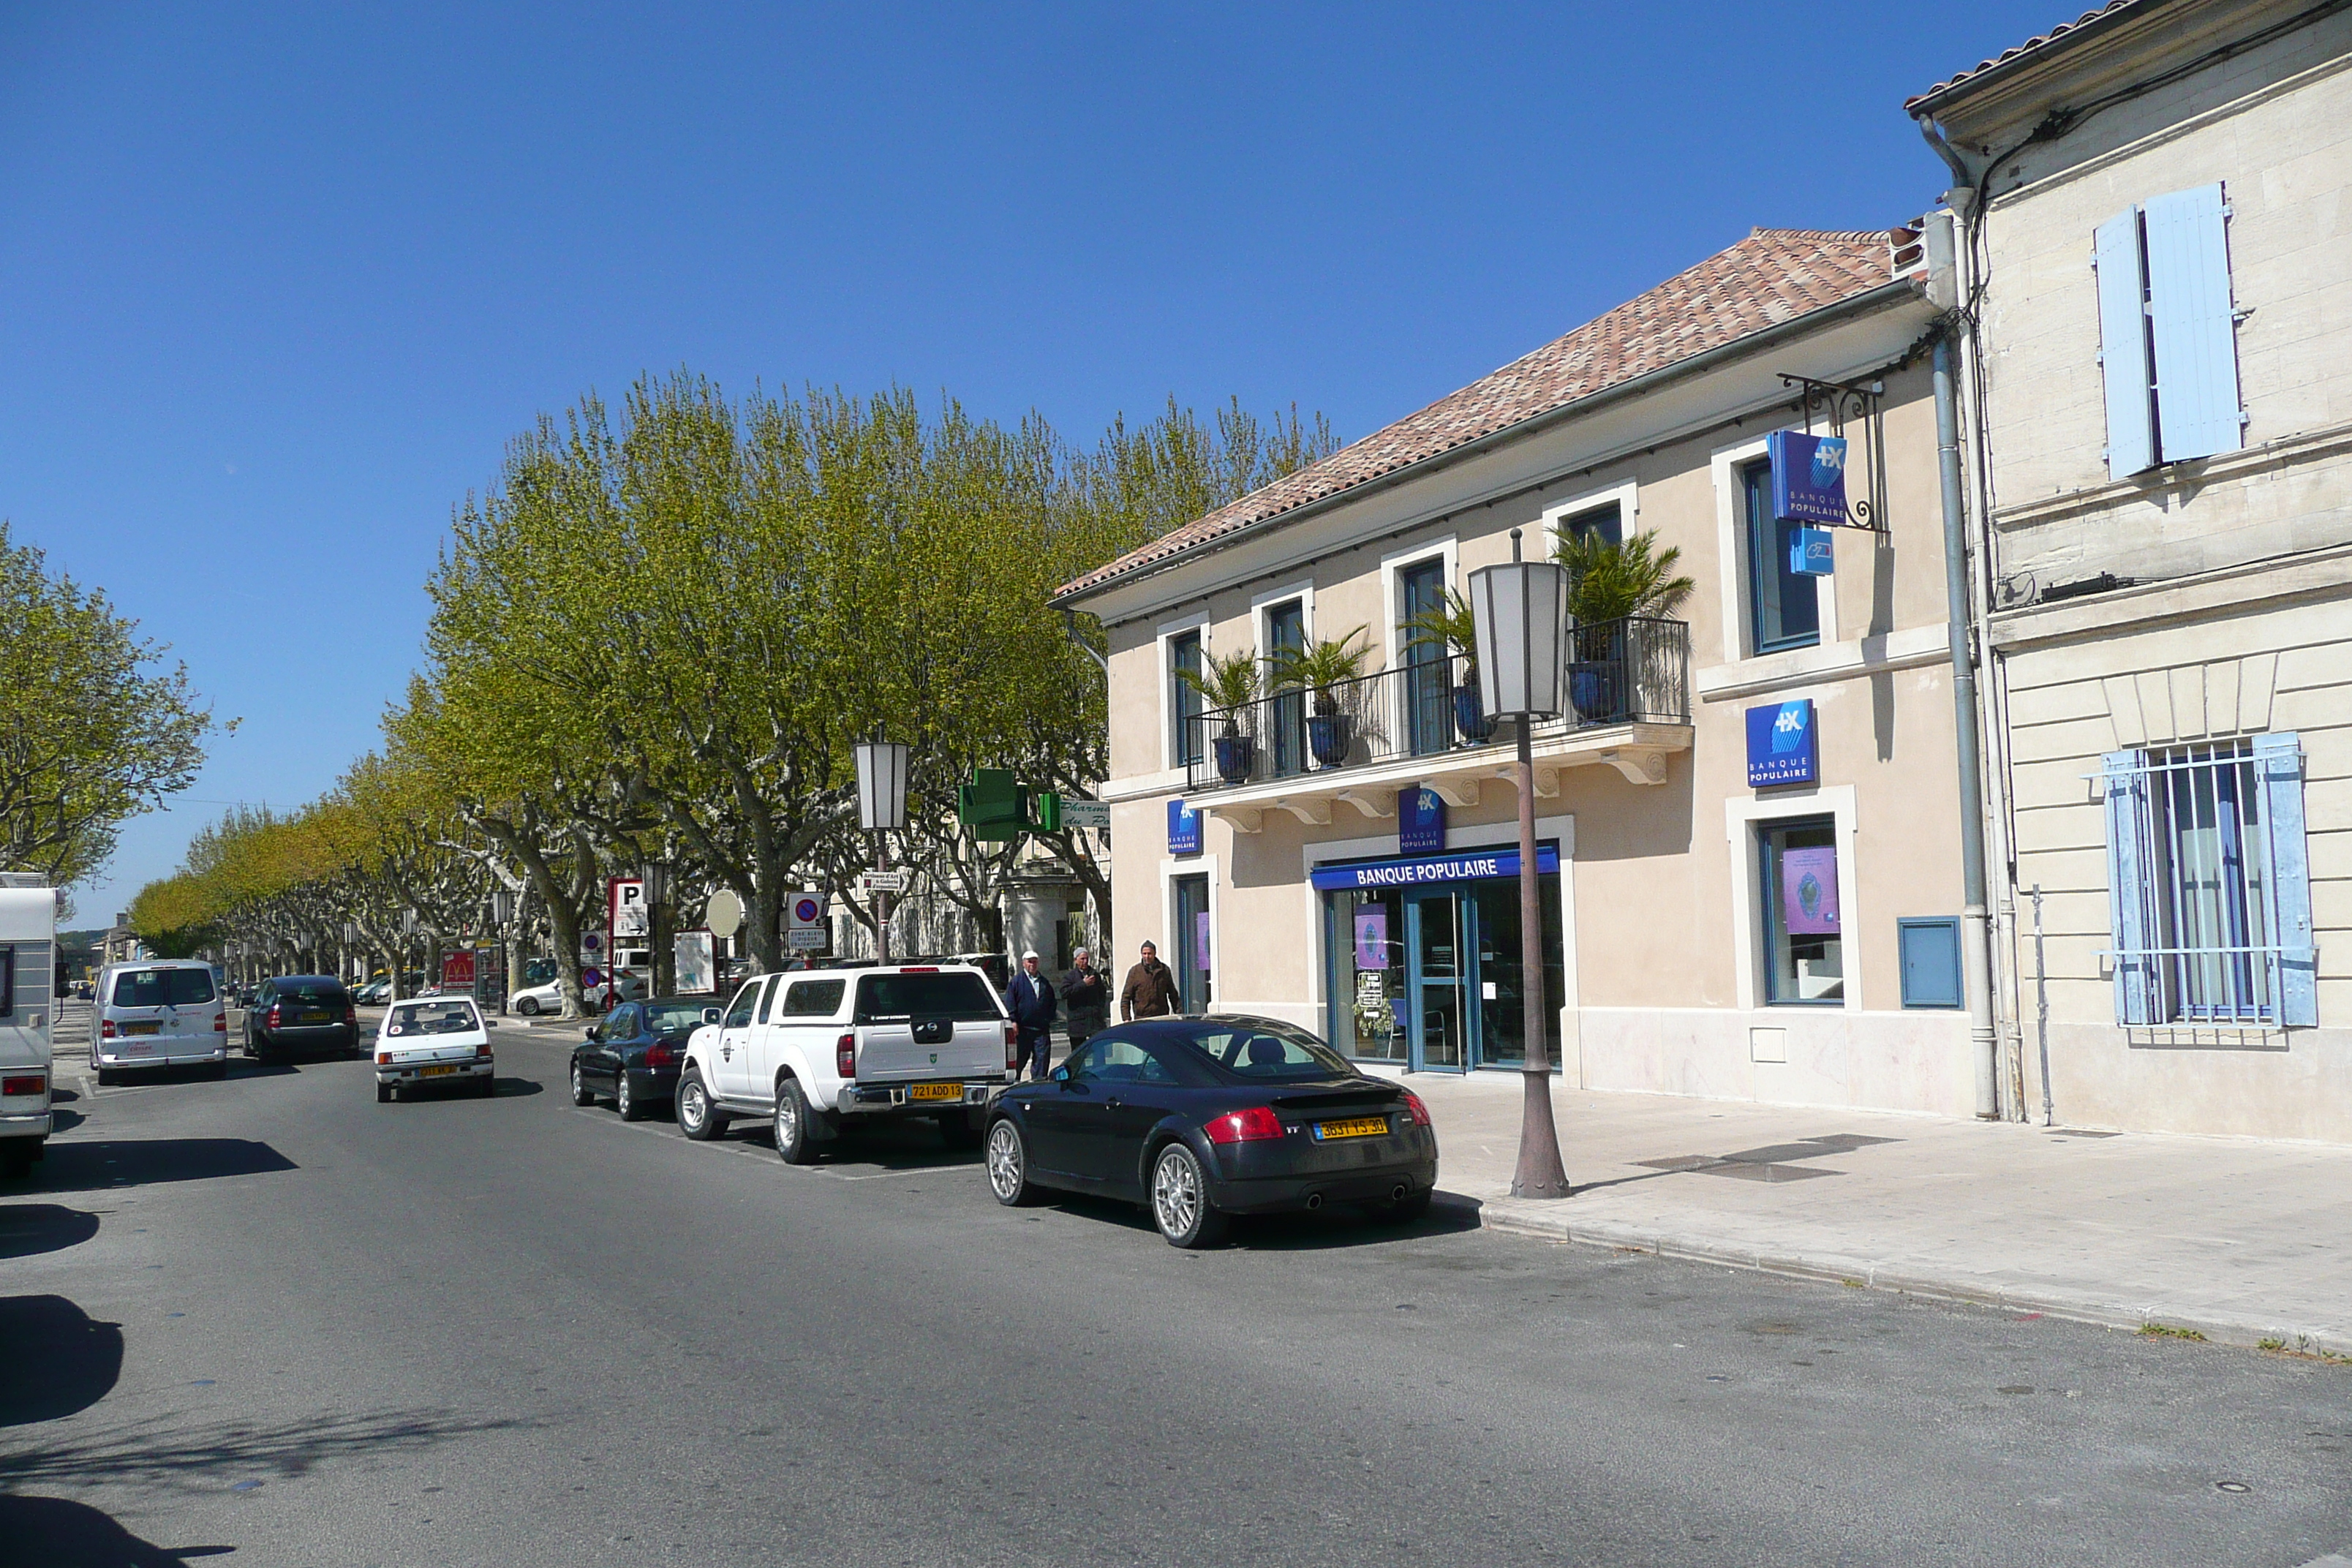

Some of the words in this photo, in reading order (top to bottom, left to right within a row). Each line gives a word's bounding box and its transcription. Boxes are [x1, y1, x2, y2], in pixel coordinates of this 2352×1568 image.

[1790, 491, 1843, 507] BANQUE
[1790, 503, 1844, 518] POPULAIRE
[1749, 757, 1806, 771] BANQUE
[1750, 769, 1807, 782] POPULAIRE
[1065, 816, 1082, 825] du
[1401, 831, 1437, 840] BANQUE
[1401, 840, 1437, 848] POPULAIRE
[1357, 867, 1414, 885] BANQUE
[1417, 859, 1498, 880] POPULAIRE
[624, 886, 639, 905] P
[913, 1086, 930, 1096] 721
[932, 1085, 949, 1096] ADD
[951, 1085, 962, 1096] 13
[1324, 1123, 1350, 1137] 3637
[1352, 1121, 1368, 1134] YS
[1371, 1119, 1384, 1132] 30
